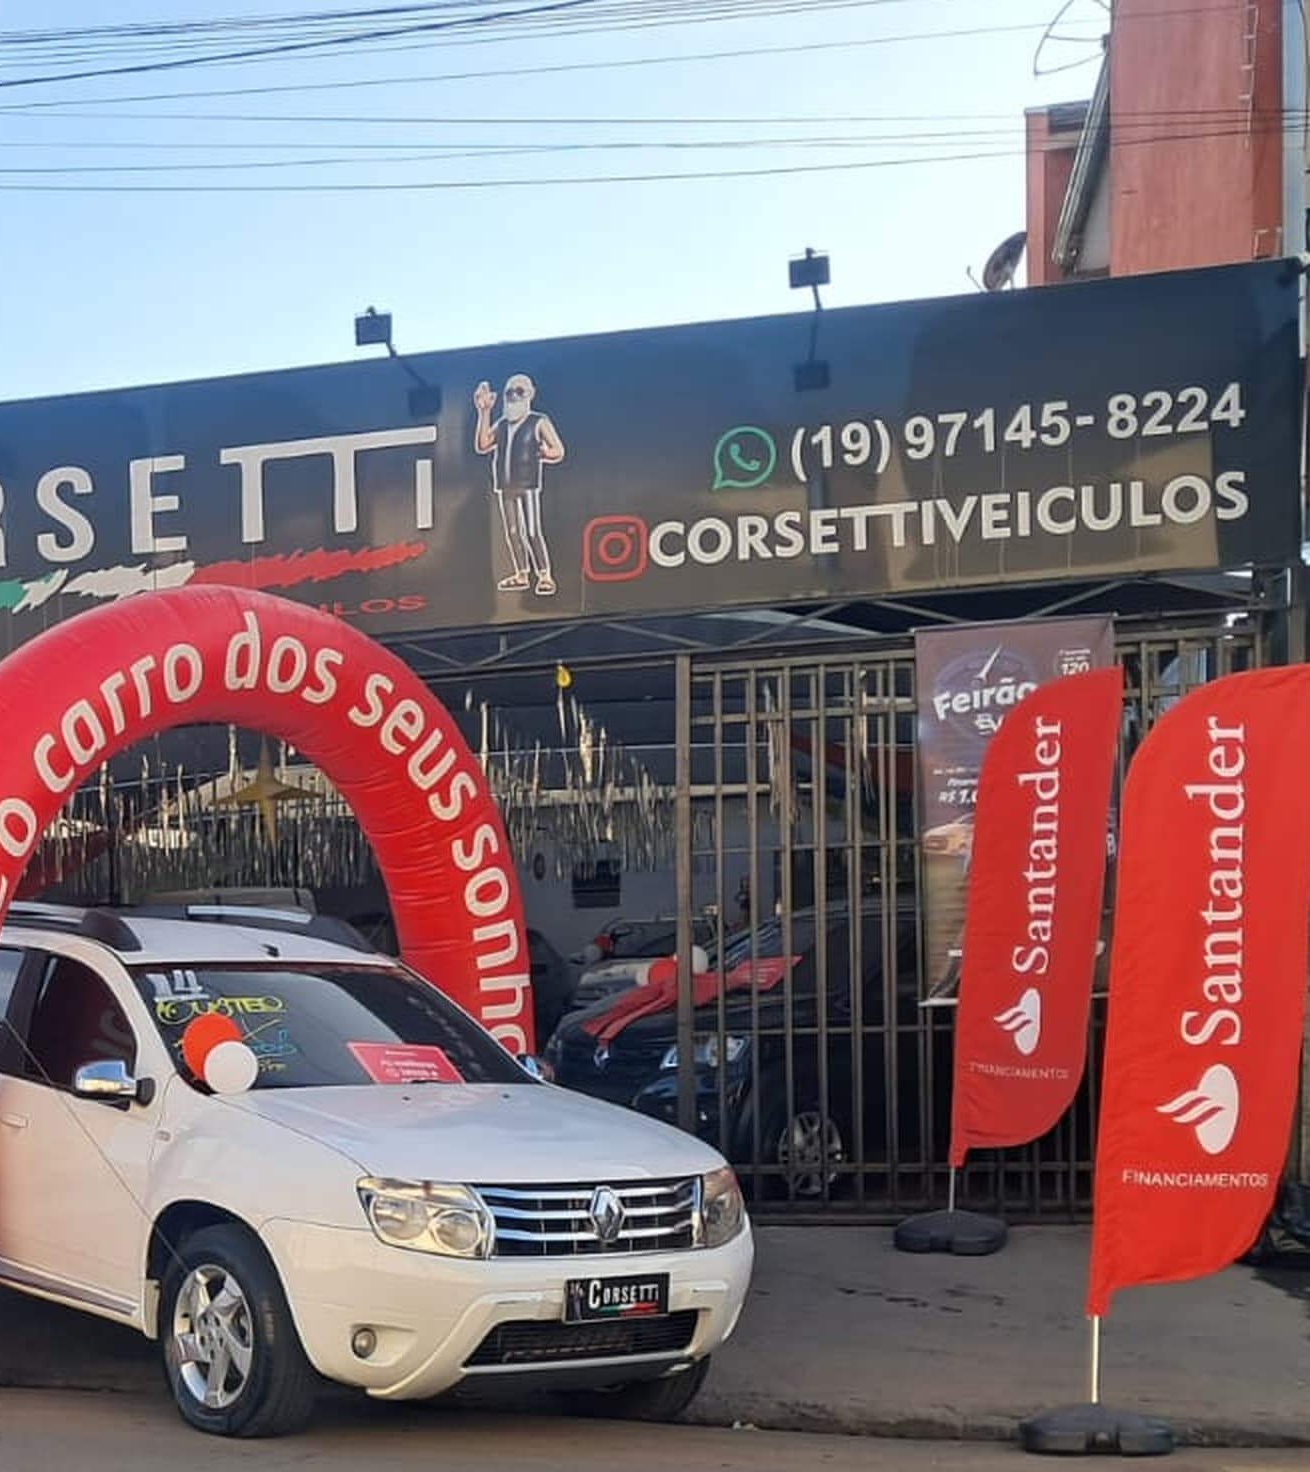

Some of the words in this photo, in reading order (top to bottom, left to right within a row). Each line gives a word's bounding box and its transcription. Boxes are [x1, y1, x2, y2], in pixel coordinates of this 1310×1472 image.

[790, 419, 891, 482] (19)
[647, 471, 1250, 569] CORSETTIVEICULOS
[32, 642, 204, 794] carro
[224, 610, 344, 705] dos
[347, 672, 478, 822] seus
[1012, 715, 1062, 975] Santander
[1180, 716, 1245, 1046] Santander
[1122, 1169, 1269, 1188] FINANCIAMENTOS
[588, 1279, 660, 1310] CORSETTI
